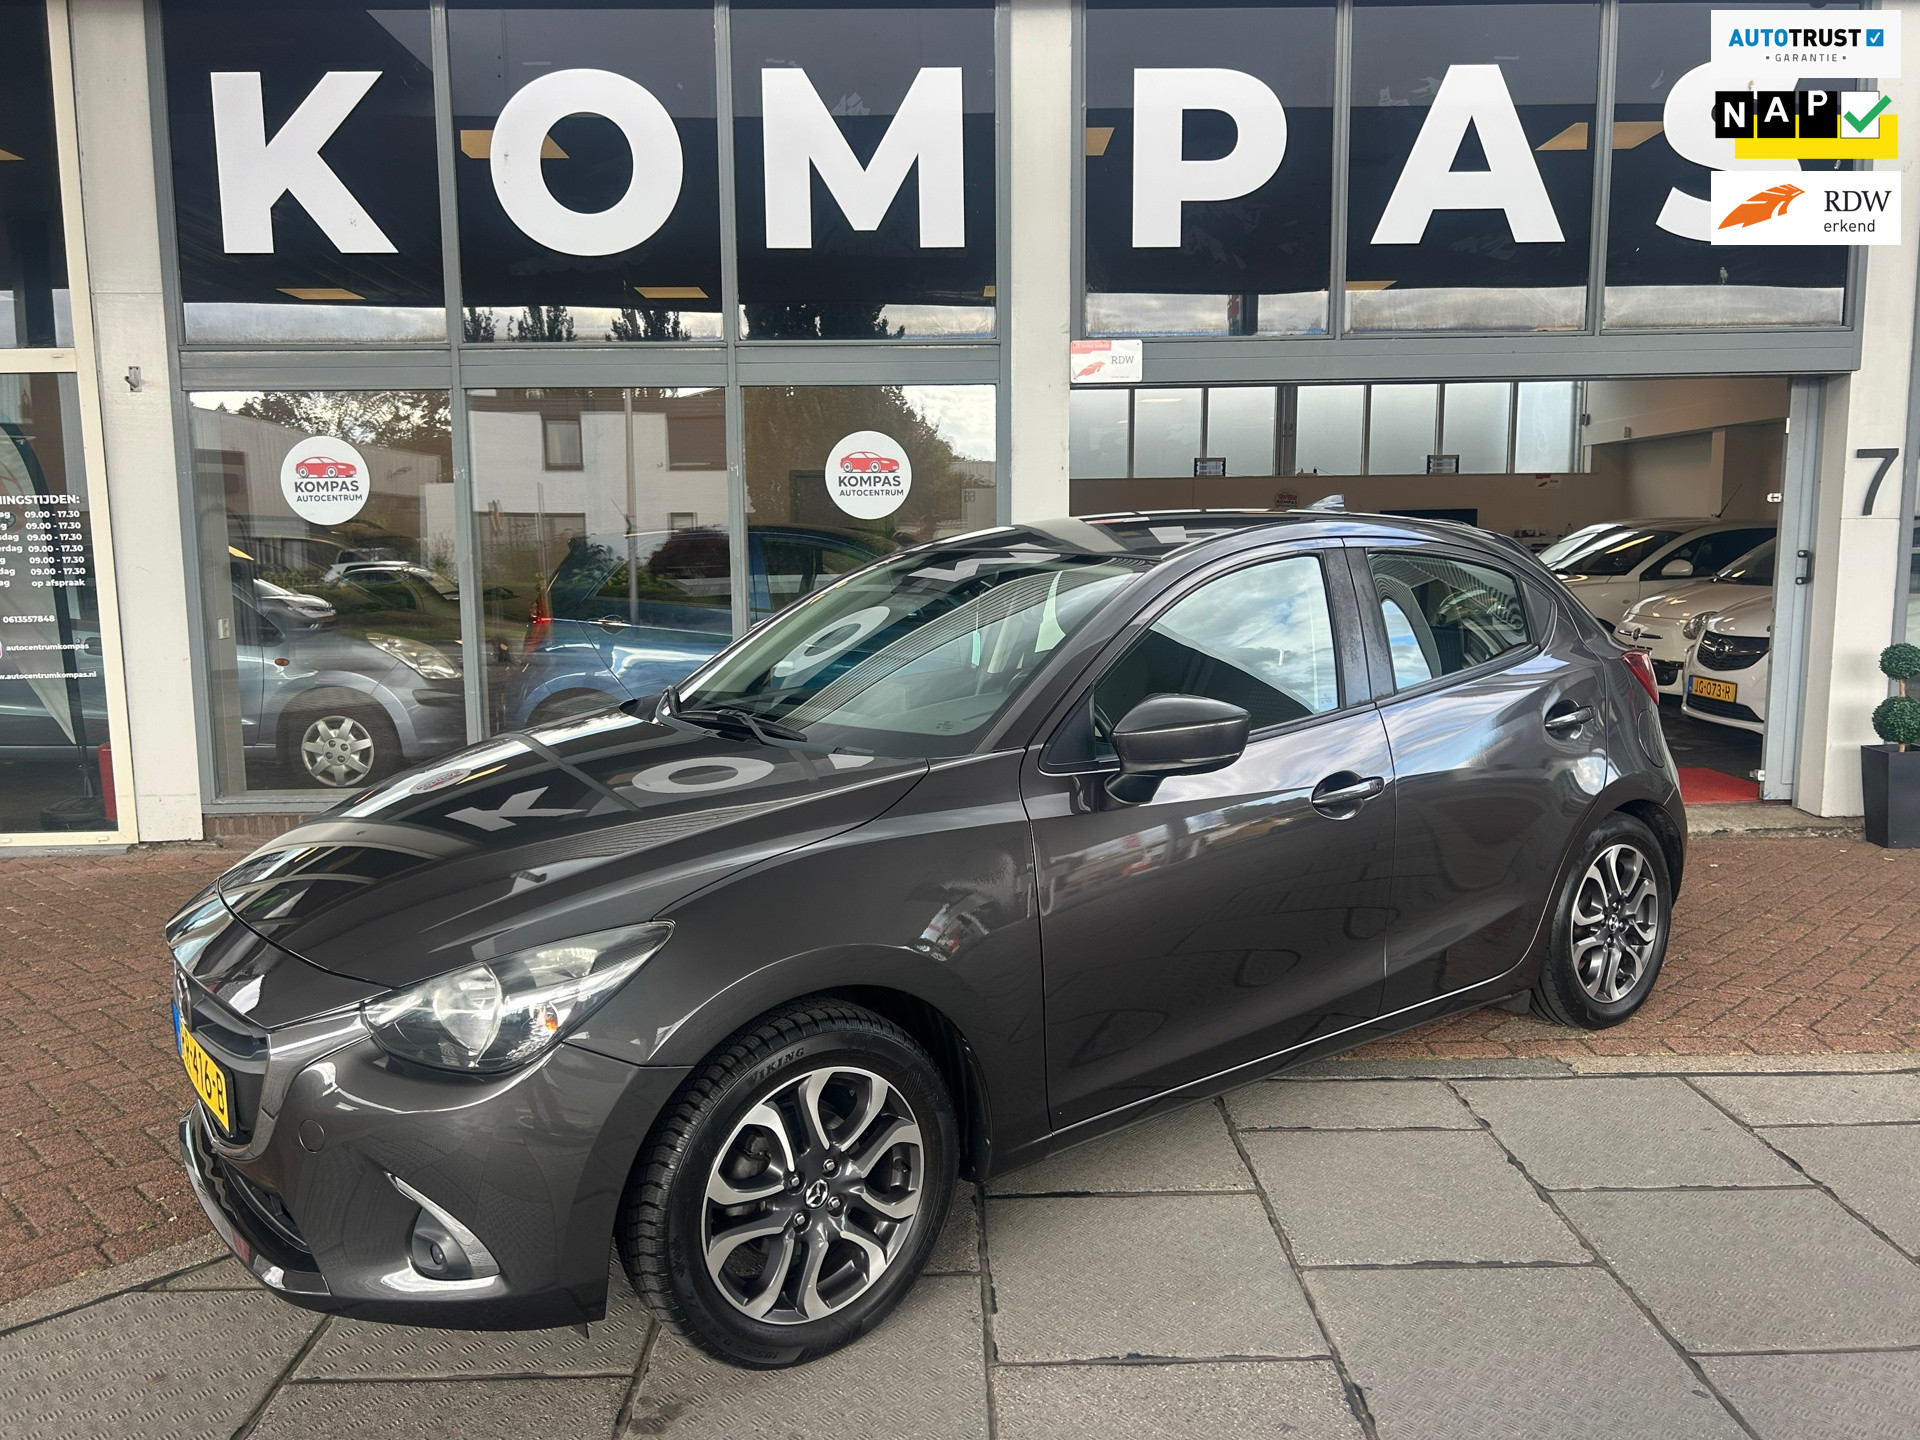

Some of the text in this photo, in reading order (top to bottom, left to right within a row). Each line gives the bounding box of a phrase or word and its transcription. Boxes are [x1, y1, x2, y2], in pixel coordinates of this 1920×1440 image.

[1111, 355, 1135, 365] RDW
[838, 475, 901, 487] KOMPAS
[1856, 447, 1900, 516] 7
[294, 480, 360, 493] KOMPAS
[839, 489, 904, 497] AUTOCENTRUM
[296, 494, 363, 503] AUTOCENTRUM
[57, 510, 80, 518] 17.30
[26, 522, 51, 530] 09.00
[32, 580, 43, 588] op
[46, 579, 85, 588] afspraak
[2, 615, 56, 623] 0613557848
[6, 643, 90, 652] autocentrumkompas
[1694, 679, 1731, 699] JG-073-R
[748, 1047, 805, 1086] VIKING
